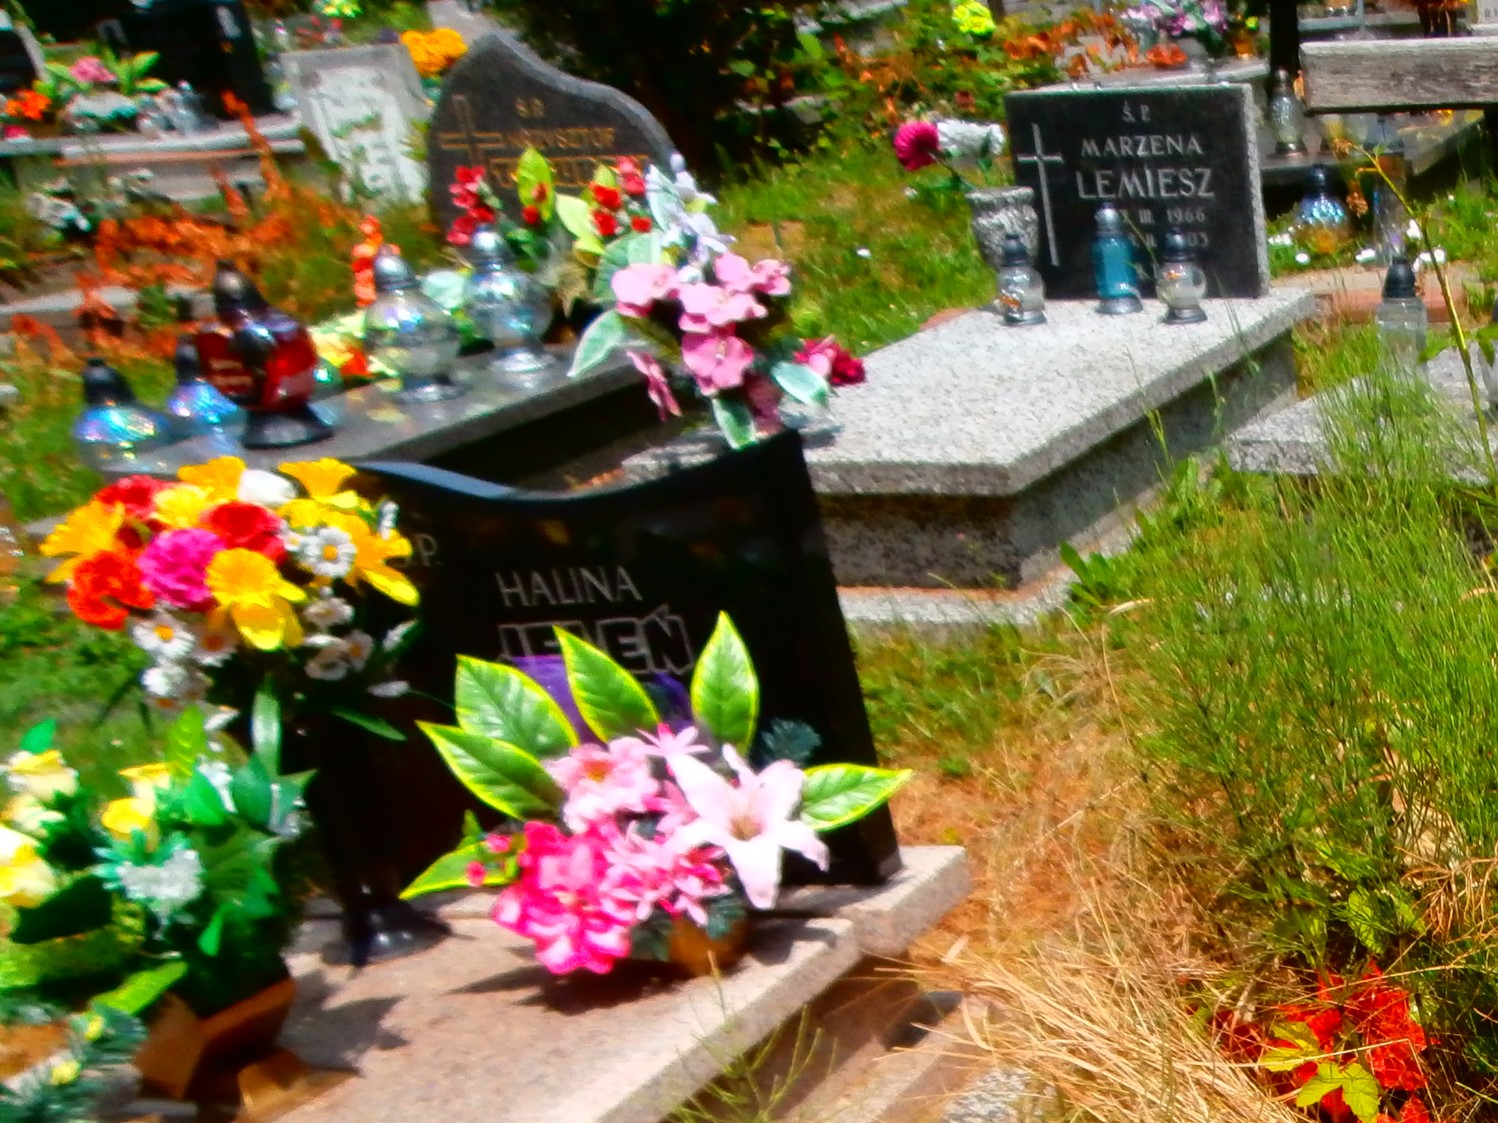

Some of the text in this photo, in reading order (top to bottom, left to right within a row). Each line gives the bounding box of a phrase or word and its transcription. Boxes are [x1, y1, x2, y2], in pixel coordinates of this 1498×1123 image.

[1081, 132, 1204, 157] MARZENA
[1075, 163, 1215, 199] LEMIESZ
[495, 566, 643, 607] HALINA
[497, 603, 694, 675] JEEŃ
